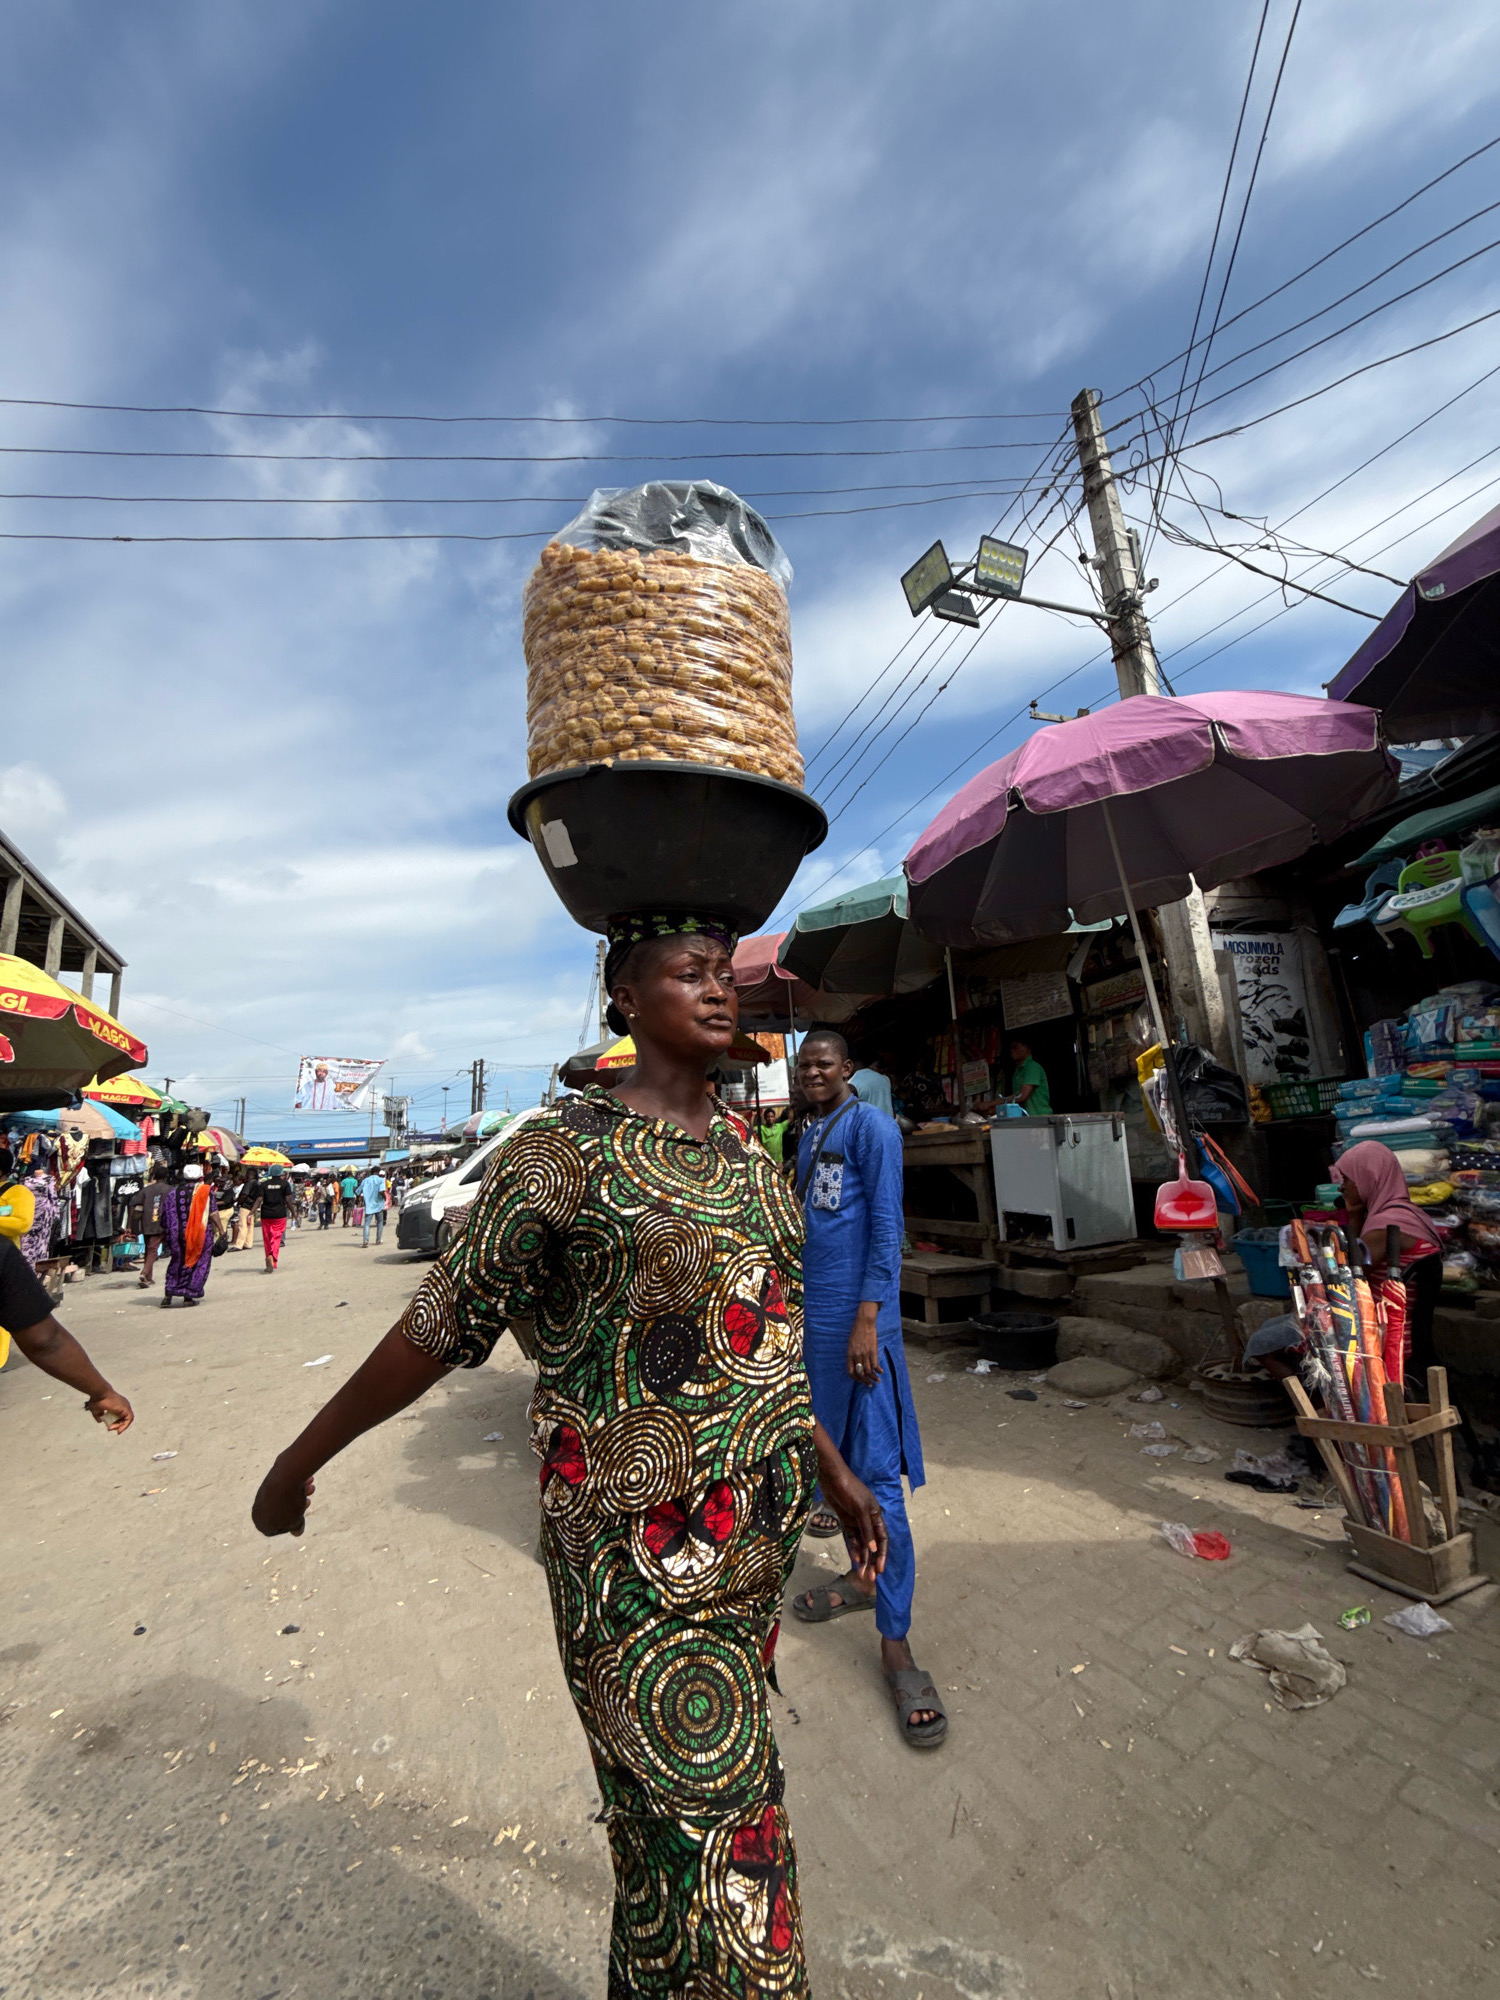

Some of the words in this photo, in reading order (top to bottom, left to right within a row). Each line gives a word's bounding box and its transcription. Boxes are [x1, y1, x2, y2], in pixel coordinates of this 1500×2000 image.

[1223, 941, 1284, 955] MOSUNMOLA
[88, 1017, 132, 1050] MAGGI
[100, 1093, 130, 1102] MAGGI
